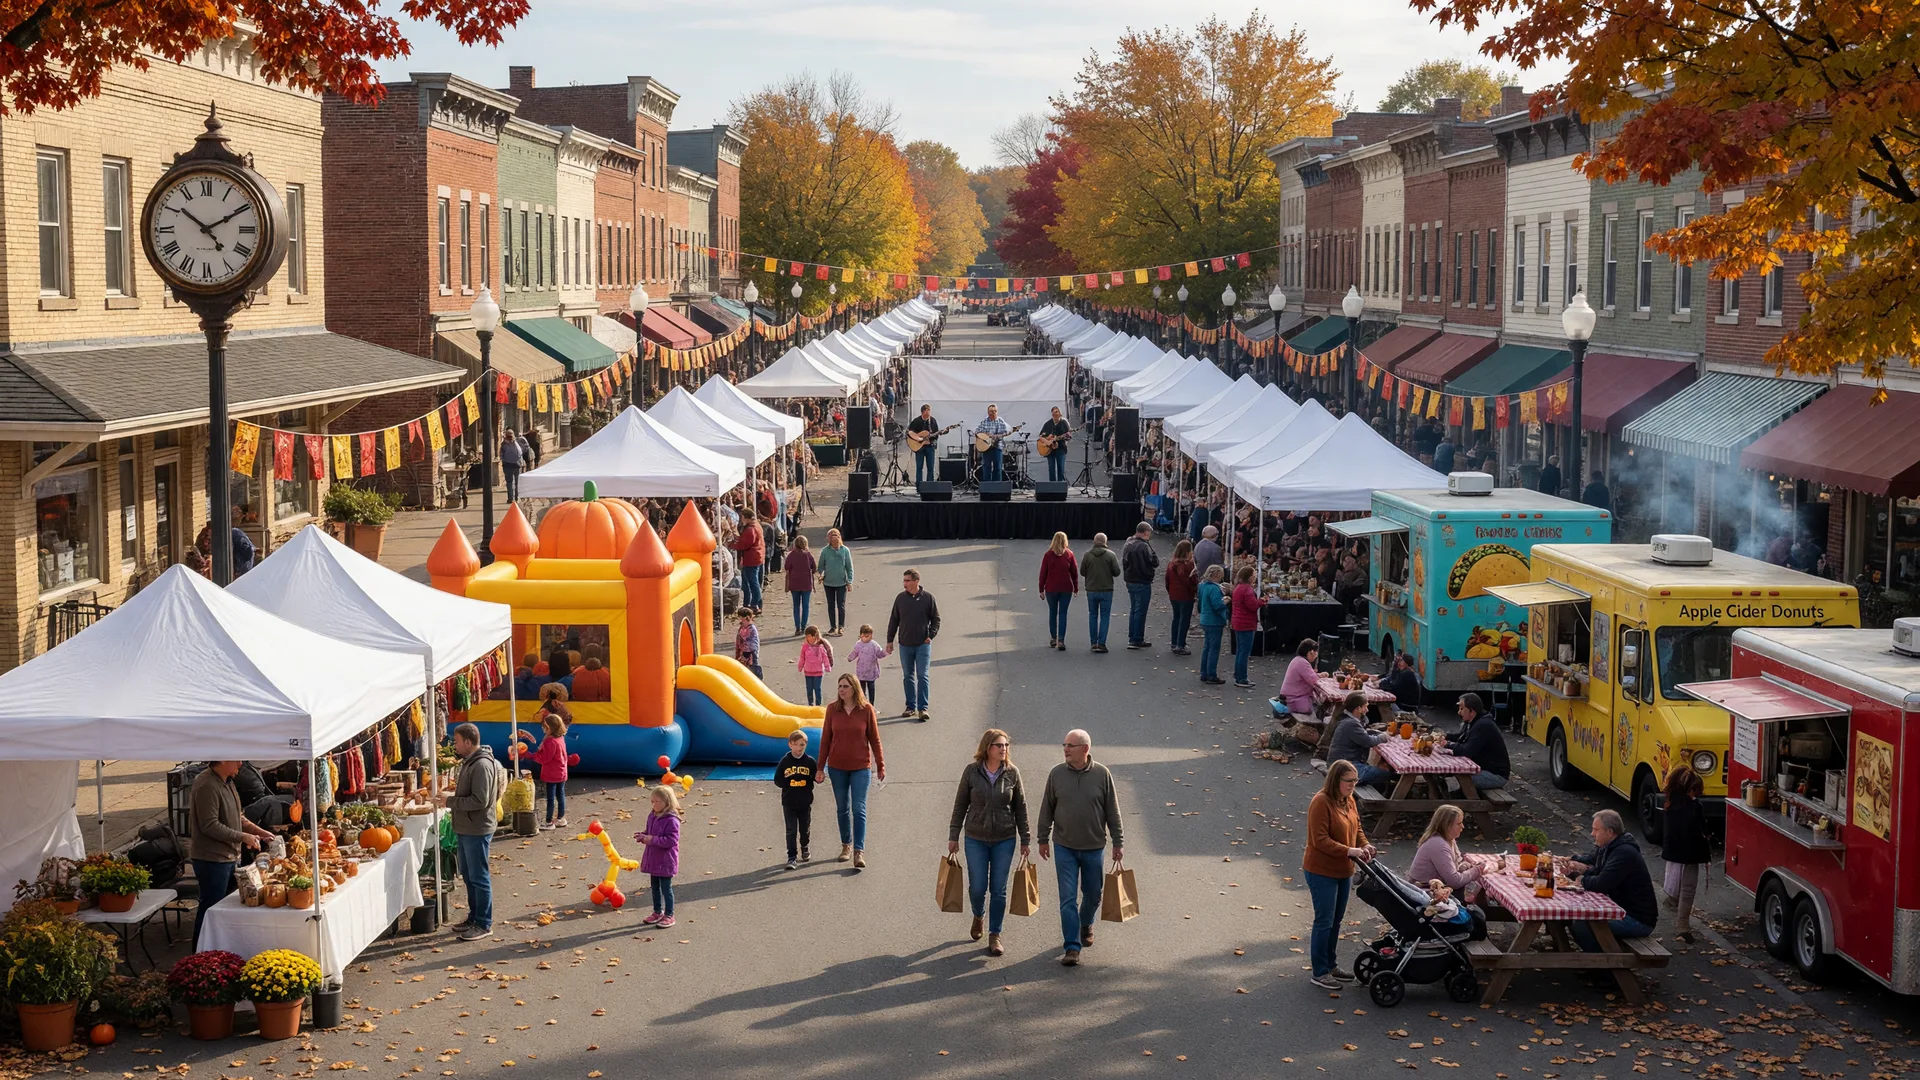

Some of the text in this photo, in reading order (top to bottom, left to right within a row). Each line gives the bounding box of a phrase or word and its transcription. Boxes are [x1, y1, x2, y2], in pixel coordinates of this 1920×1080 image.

[1679, 604, 1825, 621] Apple Cider Donuts
